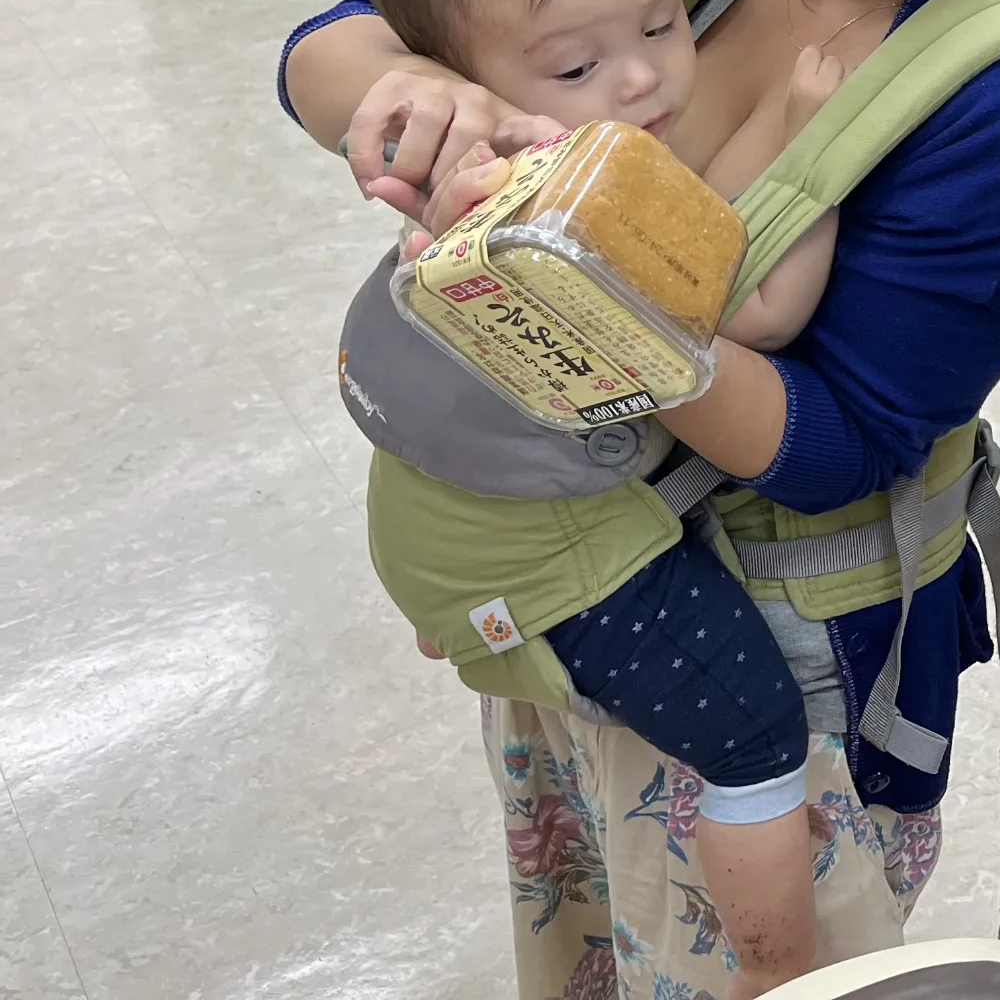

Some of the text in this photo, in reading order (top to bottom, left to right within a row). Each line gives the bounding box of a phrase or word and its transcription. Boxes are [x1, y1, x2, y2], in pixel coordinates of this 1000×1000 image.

[446, 277, 496, 301] 中甘口
[472, 314, 570, 393] 樽から生詰め!
[486, 303, 596, 377] 生みそ
[582, 392, 656, 423] 国産米100%
